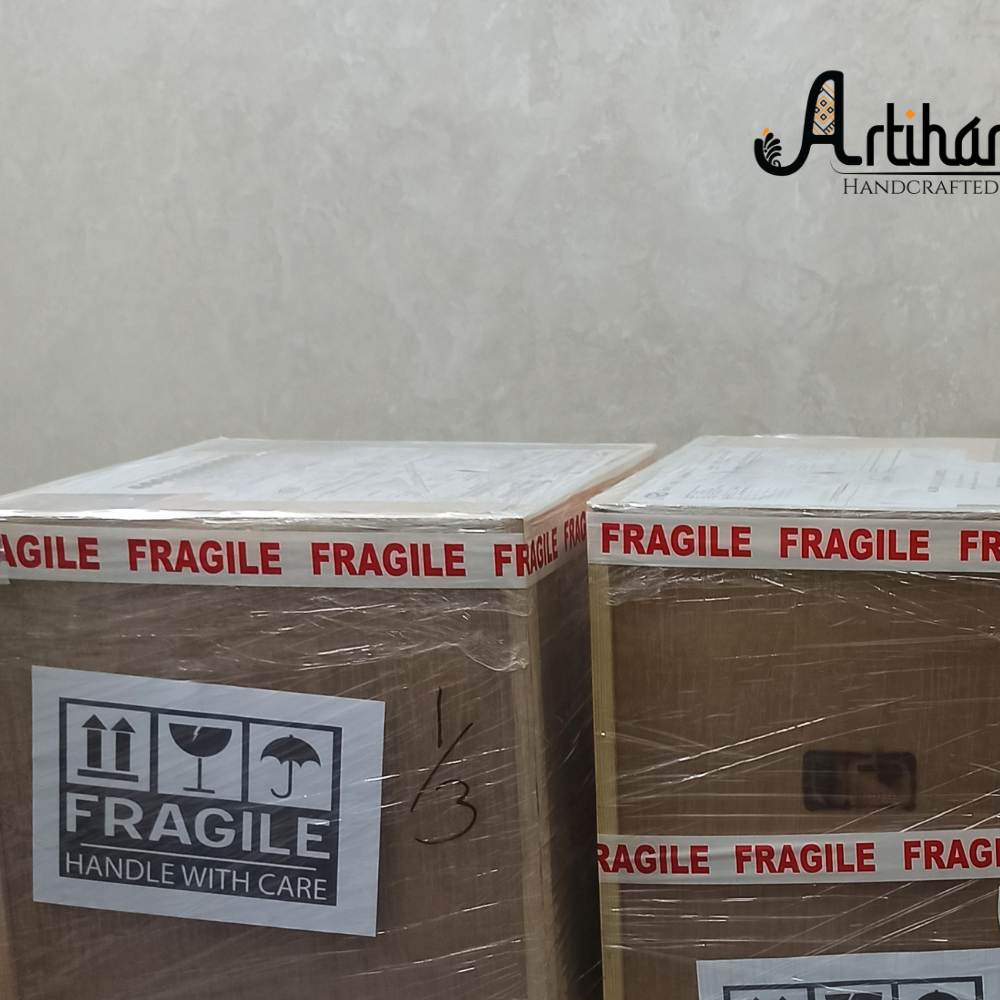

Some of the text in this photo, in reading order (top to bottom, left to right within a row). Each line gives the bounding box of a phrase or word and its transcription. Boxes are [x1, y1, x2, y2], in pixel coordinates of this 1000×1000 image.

[127, 539, 283, 577] FRAGILE
[311, 542, 467, 578] FRAGILE
[493, 527, 559, 578] FRAGILE
[601, 522, 752, 559] FRAGILE
[780, 527, 930, 562] FRAGILE
[65, 791, 331, 860] FRAGILE
[65, 852, 328, 901] HANDLE WITH CARE
[735, 842, 876, 875] FRAGILE
